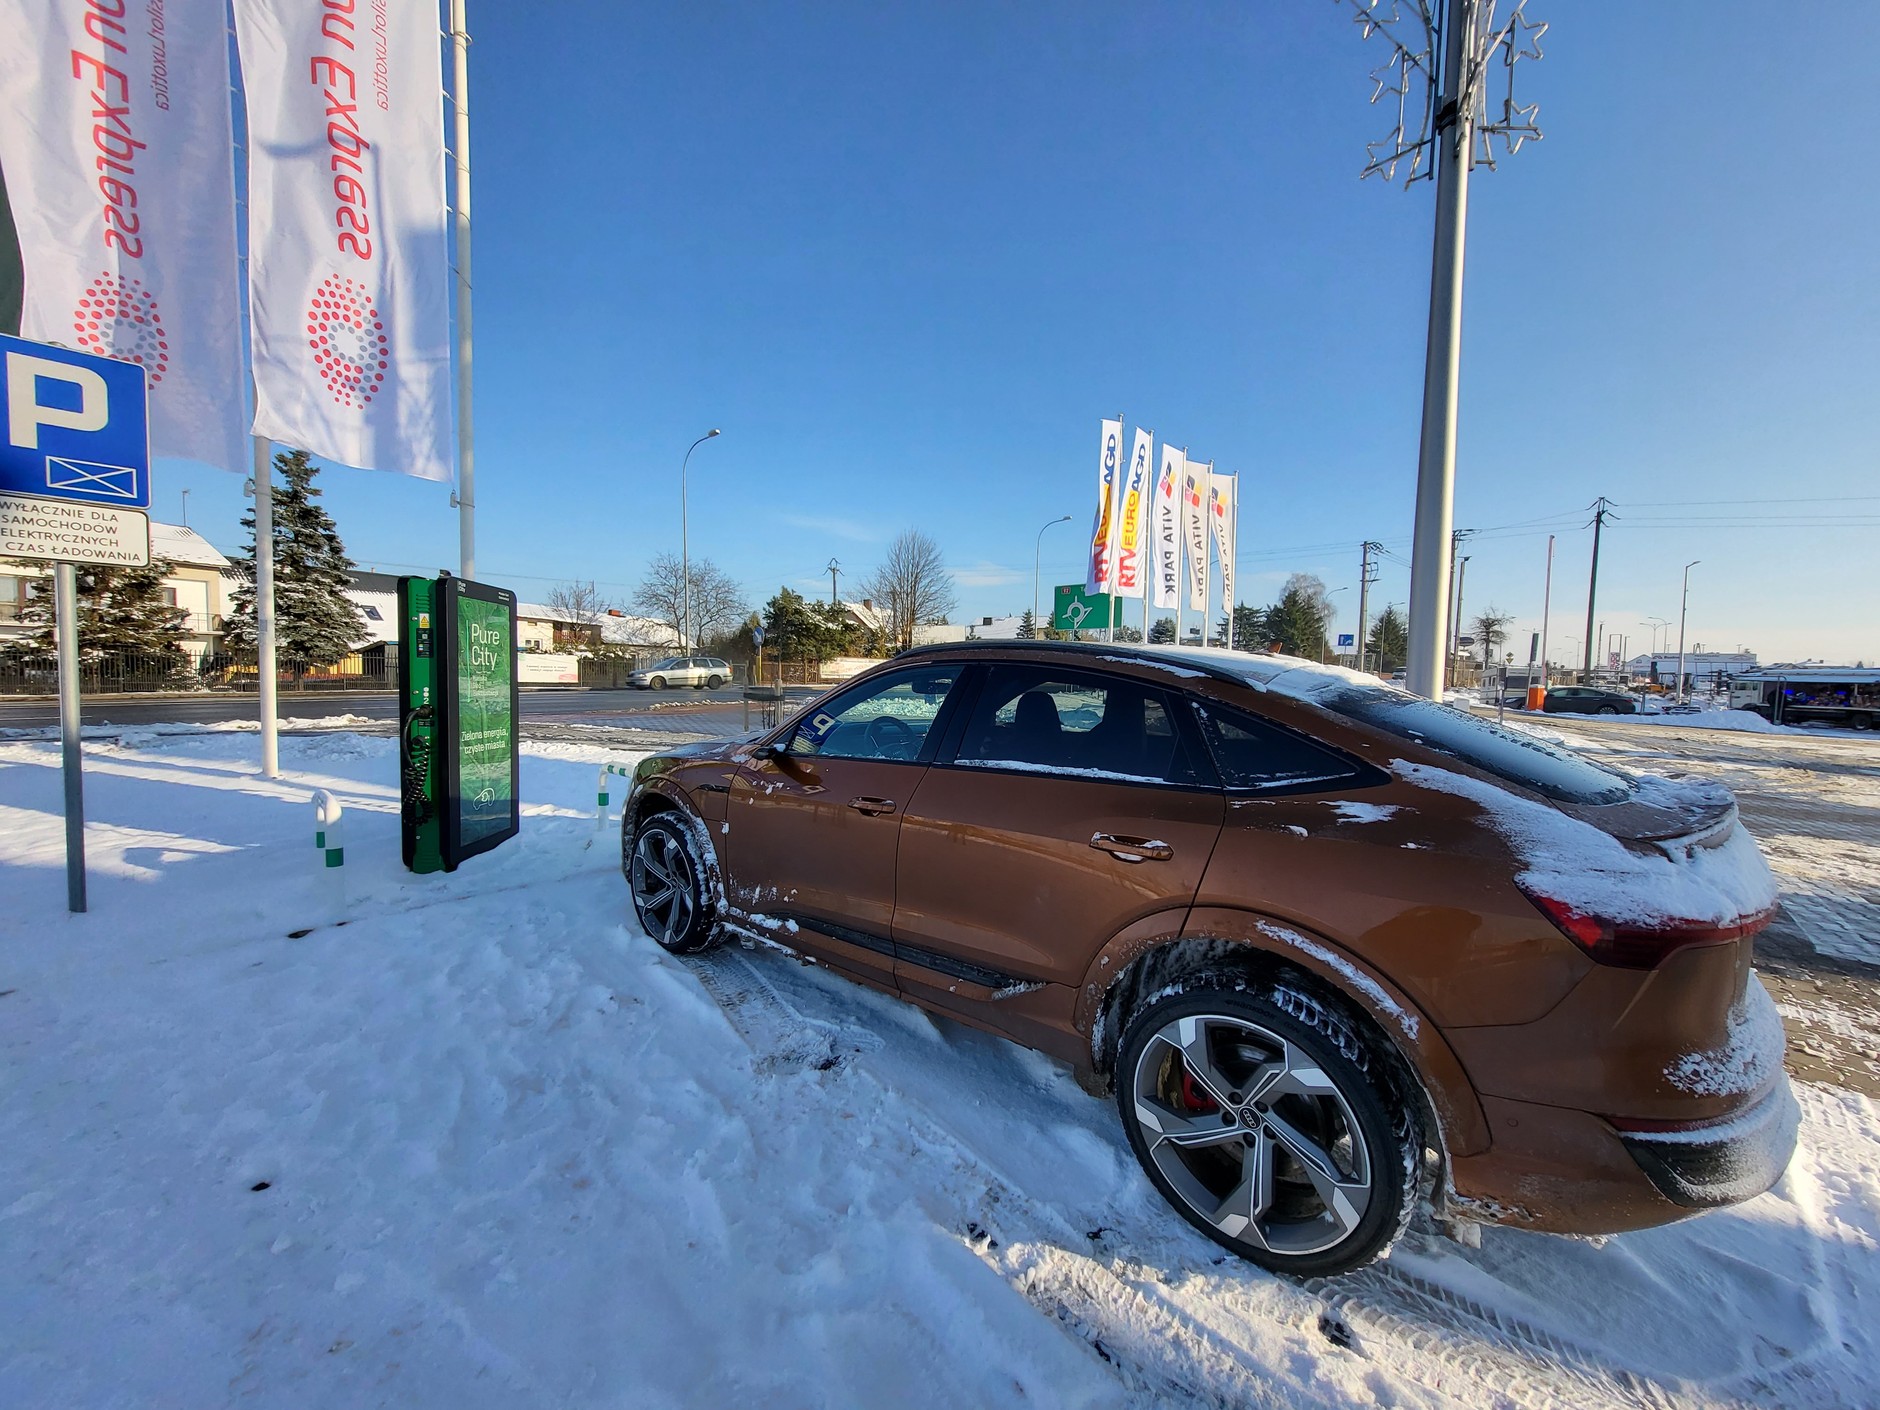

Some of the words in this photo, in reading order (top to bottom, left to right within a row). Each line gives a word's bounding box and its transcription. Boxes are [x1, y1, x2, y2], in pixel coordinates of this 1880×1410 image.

[6, 351, 108, 449] P
[1132, 443, 1146, 492] AGD
[0, 501, 85, 519] WYŁĄCZNIE
[91, 511, 119, 522] DLA
[1093, 542, 1108, 583] RTV
[1104, 433, 1116, 485] AGD
[2, 514, 118, 535] SAMOCHODÓW
[1124, 494, 1136, 546] EURO
[0, 528, 119, 547] ELEKTRYCZNYCH
[5, 541, 45, 553] CZAS
[51, 545, 141, 561] ŁADOWANIA
[1118, 548, 1137, 588] RTV
[471, 623, 500, 645] Pure
[471, 645, 498, 671] City
[461, 730, 483, 742] Zielona
[483, 726, 509, 739] energia,
[464, 742, 485, 755] czyste
[485, 740, 506, 750] miasta
